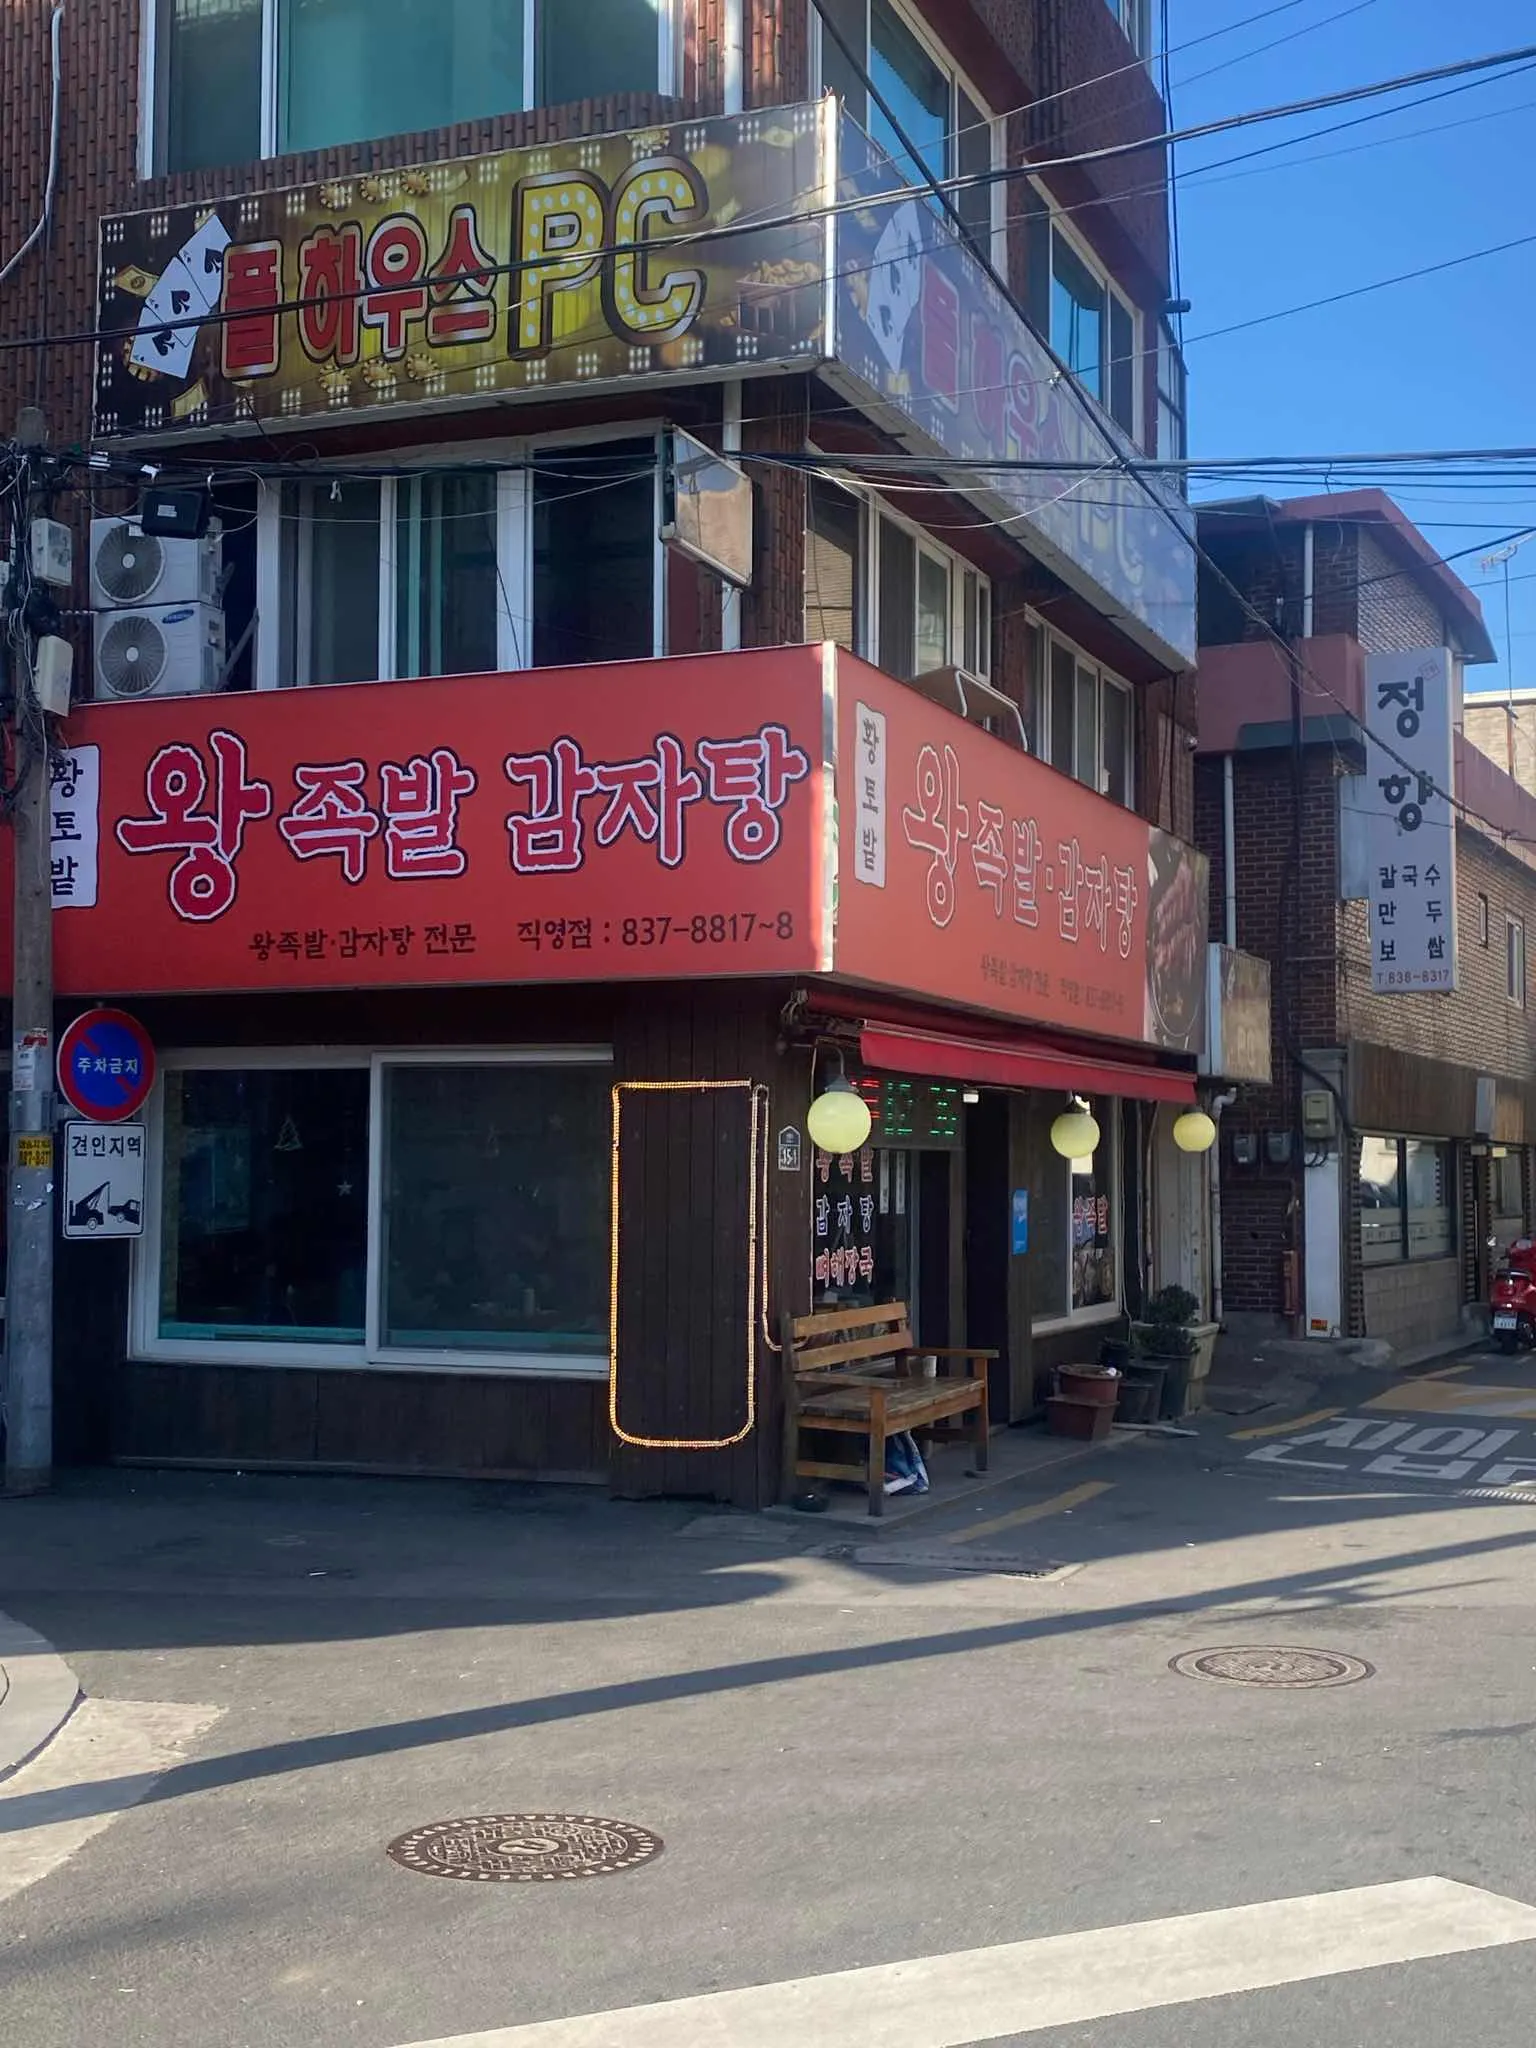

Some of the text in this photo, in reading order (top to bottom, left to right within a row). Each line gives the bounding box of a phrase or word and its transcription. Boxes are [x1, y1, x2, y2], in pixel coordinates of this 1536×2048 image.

[508, 156, 708, 361] PC
[114, 722, 810, 924] 왕족발 감자탕
[424, 922, 477, 955] 전문
[517, 916, 593, 951] 직영점
[622, 911, 794, 946] 837-8817~8
[77, 1057, 139, 1074] 주차금지
[72, 1134, 142, 1158] 견인지역
